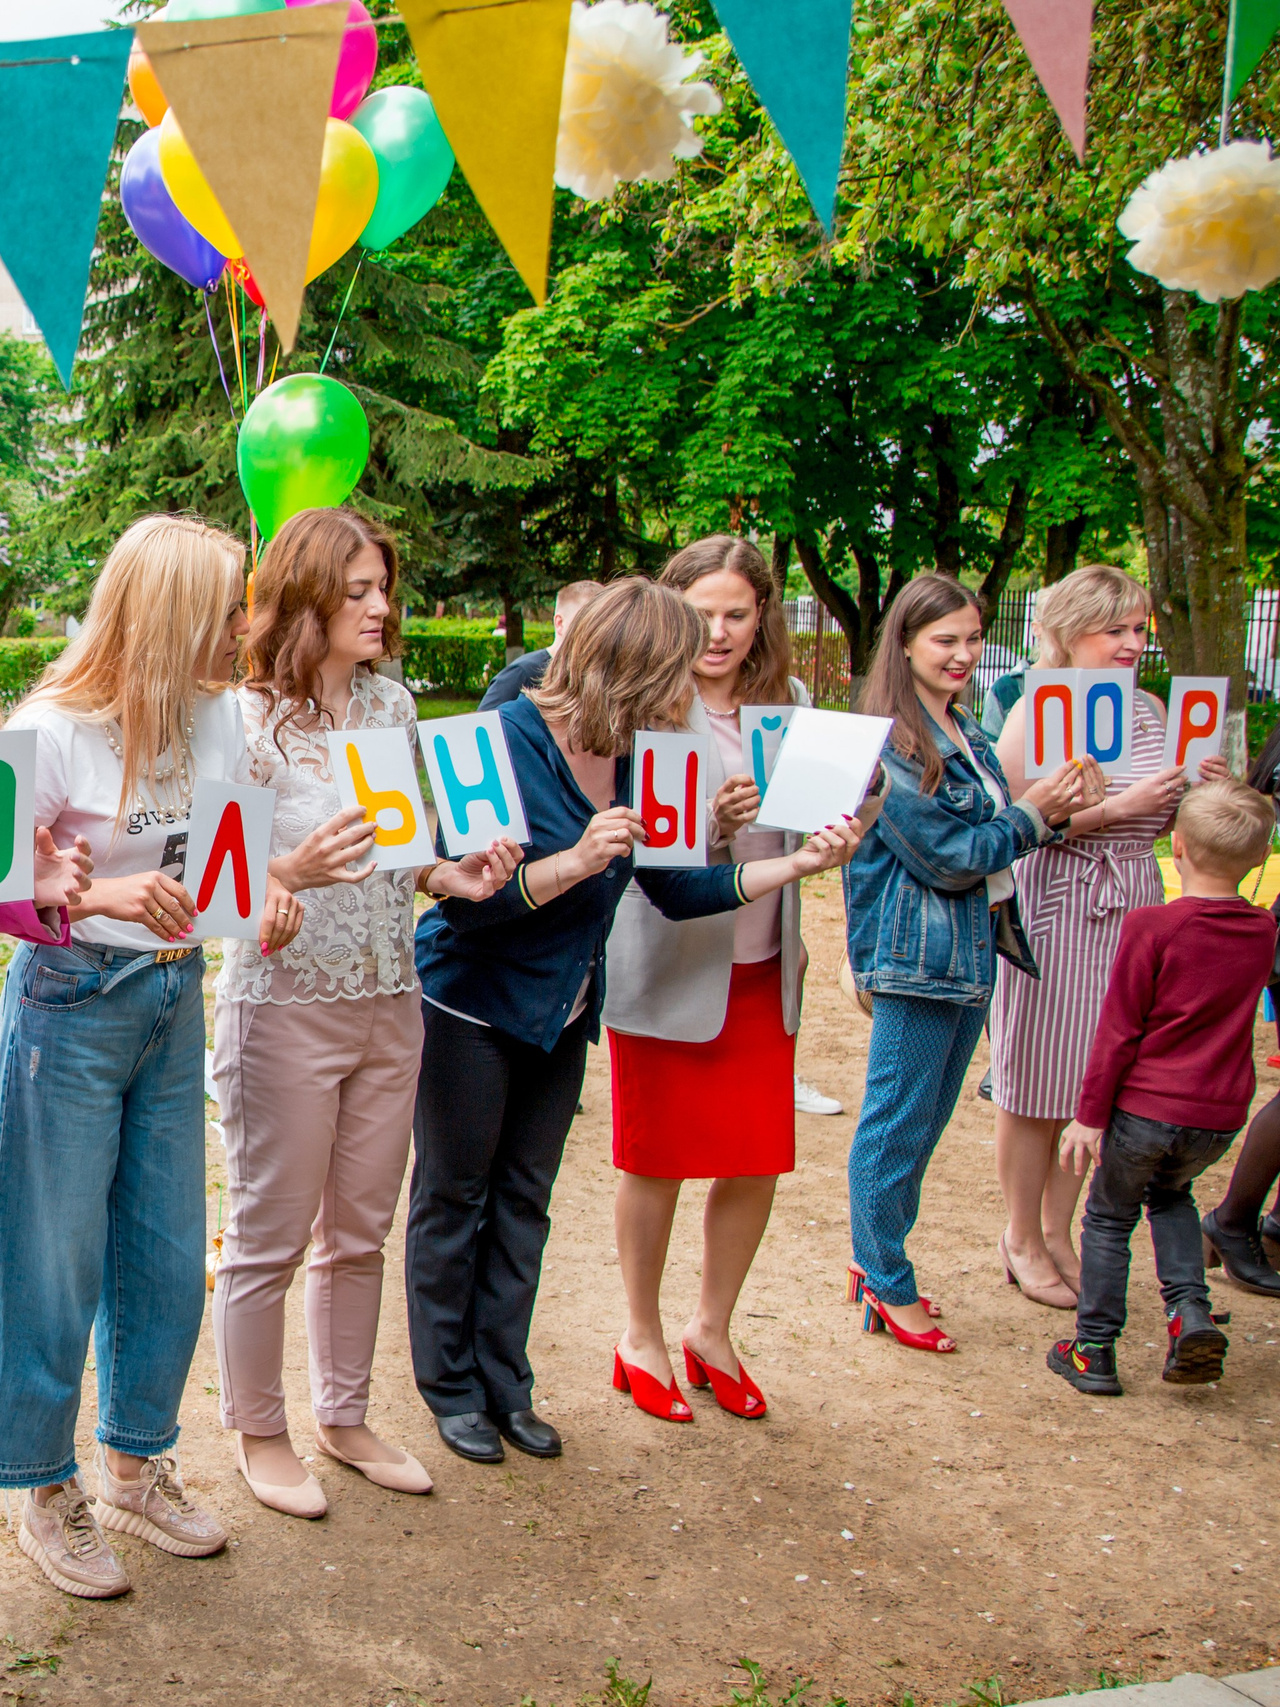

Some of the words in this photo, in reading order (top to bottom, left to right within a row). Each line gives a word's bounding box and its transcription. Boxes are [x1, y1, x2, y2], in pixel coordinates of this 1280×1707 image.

[1034, 684, 1073, 767] П
[1086, 682, 1123, 763] О
[434, 727, 509, 835] Н
[641, 748, 698, 850] Ы
[196, 800, 251, 919] Л
